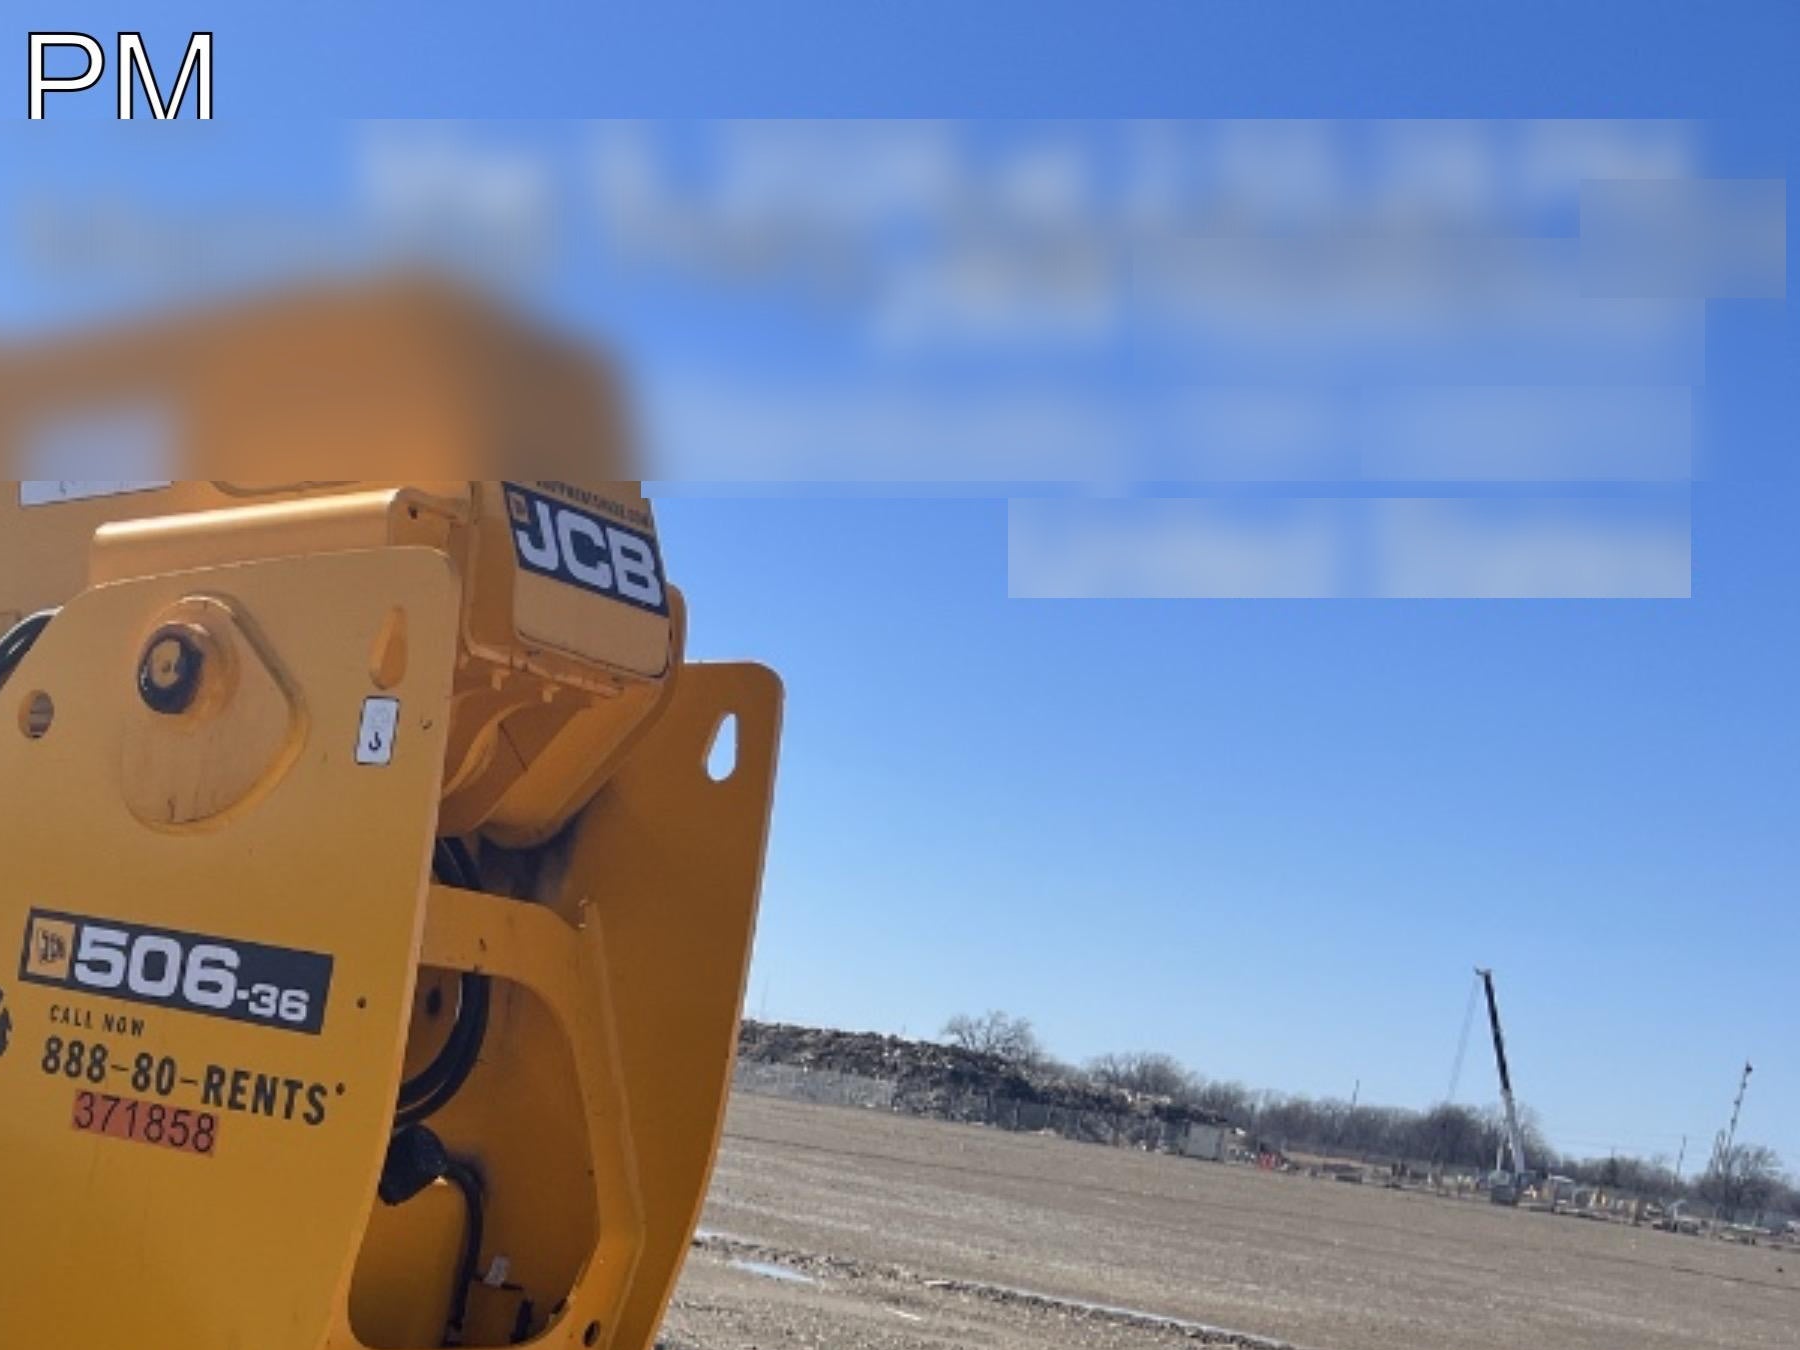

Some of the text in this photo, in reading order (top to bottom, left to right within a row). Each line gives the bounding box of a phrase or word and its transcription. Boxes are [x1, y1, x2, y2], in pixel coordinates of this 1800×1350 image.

[515, 499, 664, 608] JCB
[74, 925, 311, 1023] 506-36
[49, 1004, 146, 1037] CALL NOW
[40, 1035, 328, 1126] 888-80-RENTS
[74, 1090, 216, 1154] 371858
